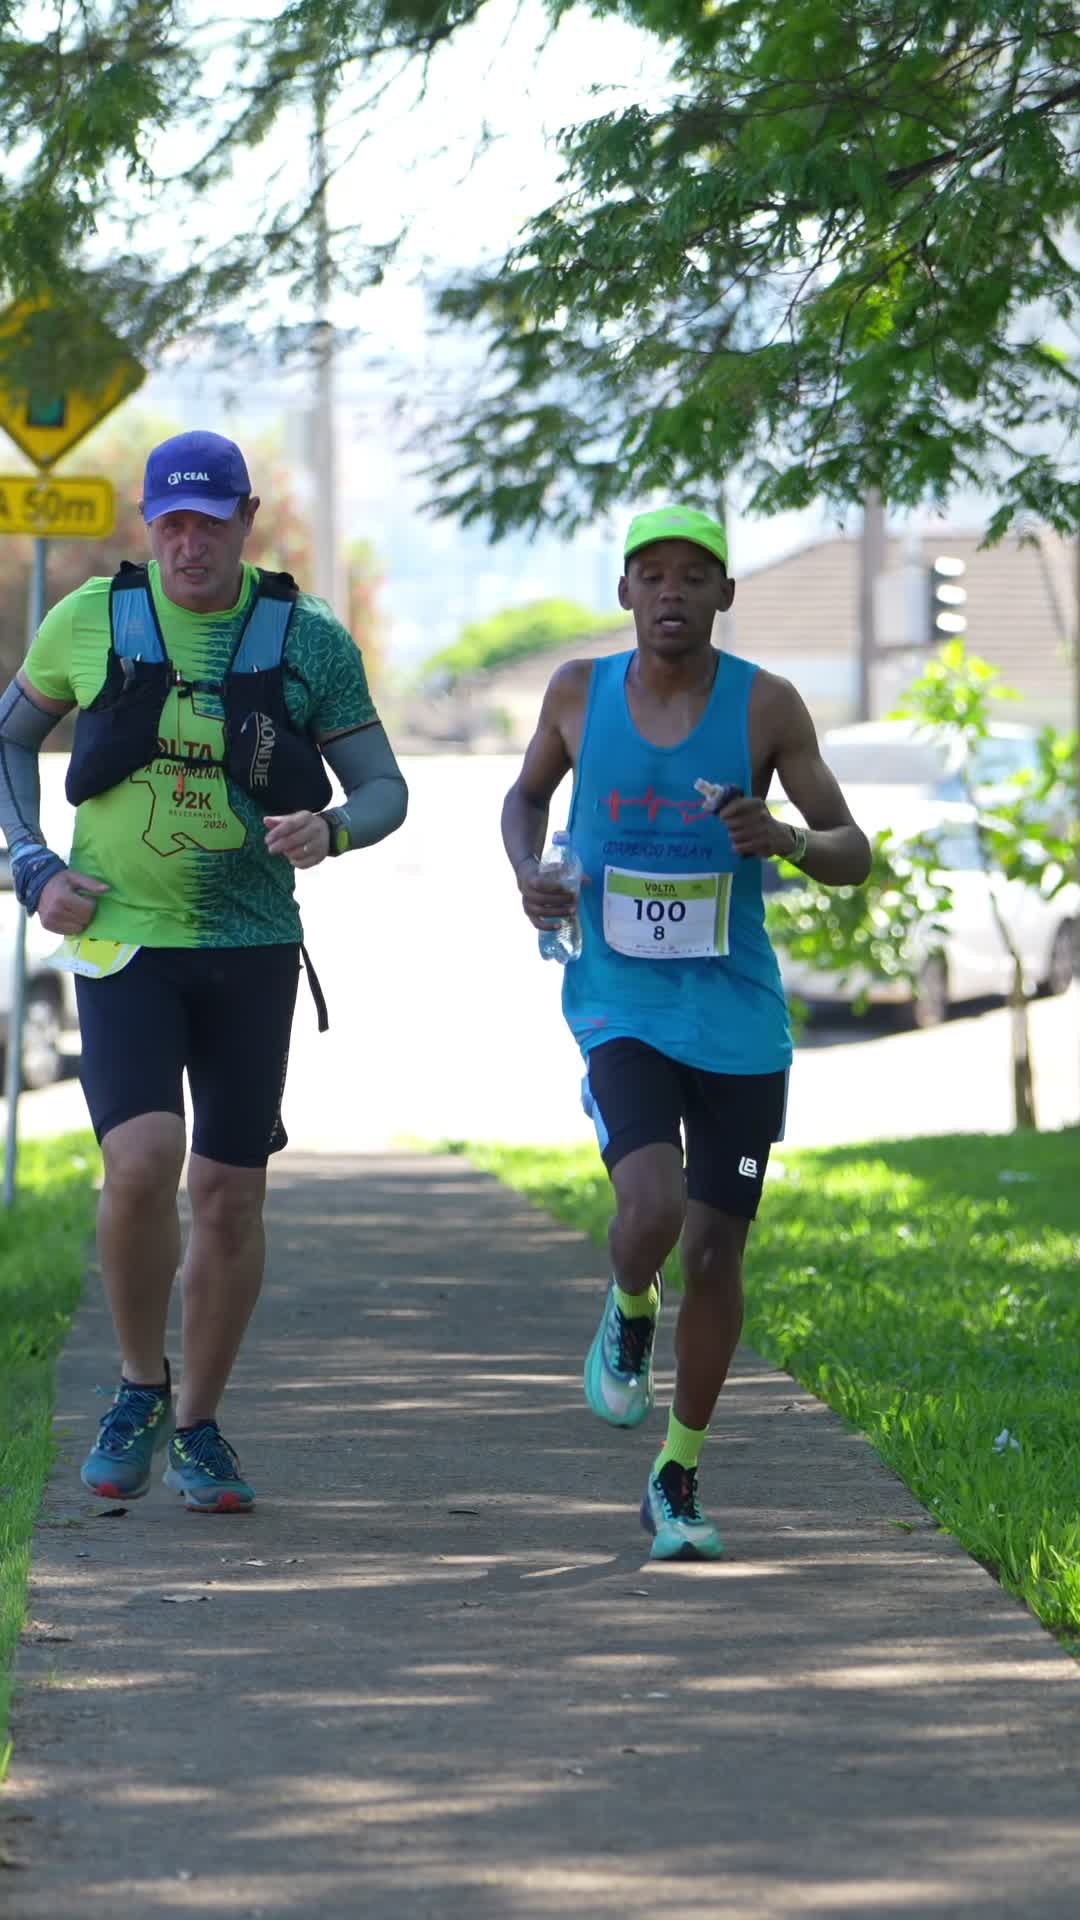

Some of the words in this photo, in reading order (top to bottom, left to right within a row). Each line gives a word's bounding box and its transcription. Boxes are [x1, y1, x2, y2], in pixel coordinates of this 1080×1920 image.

[183, 472, 210, 481] CEAL
[254, 712, 276, 786] AONIJIE
[156, 763, 220, 780] LONDRINA
[172, 791, 212, 810] 92K
[644, 882, 676, 893] VOLTA
[634, 899, 686, 922] 100
[653, 925, 665, 941] 8
